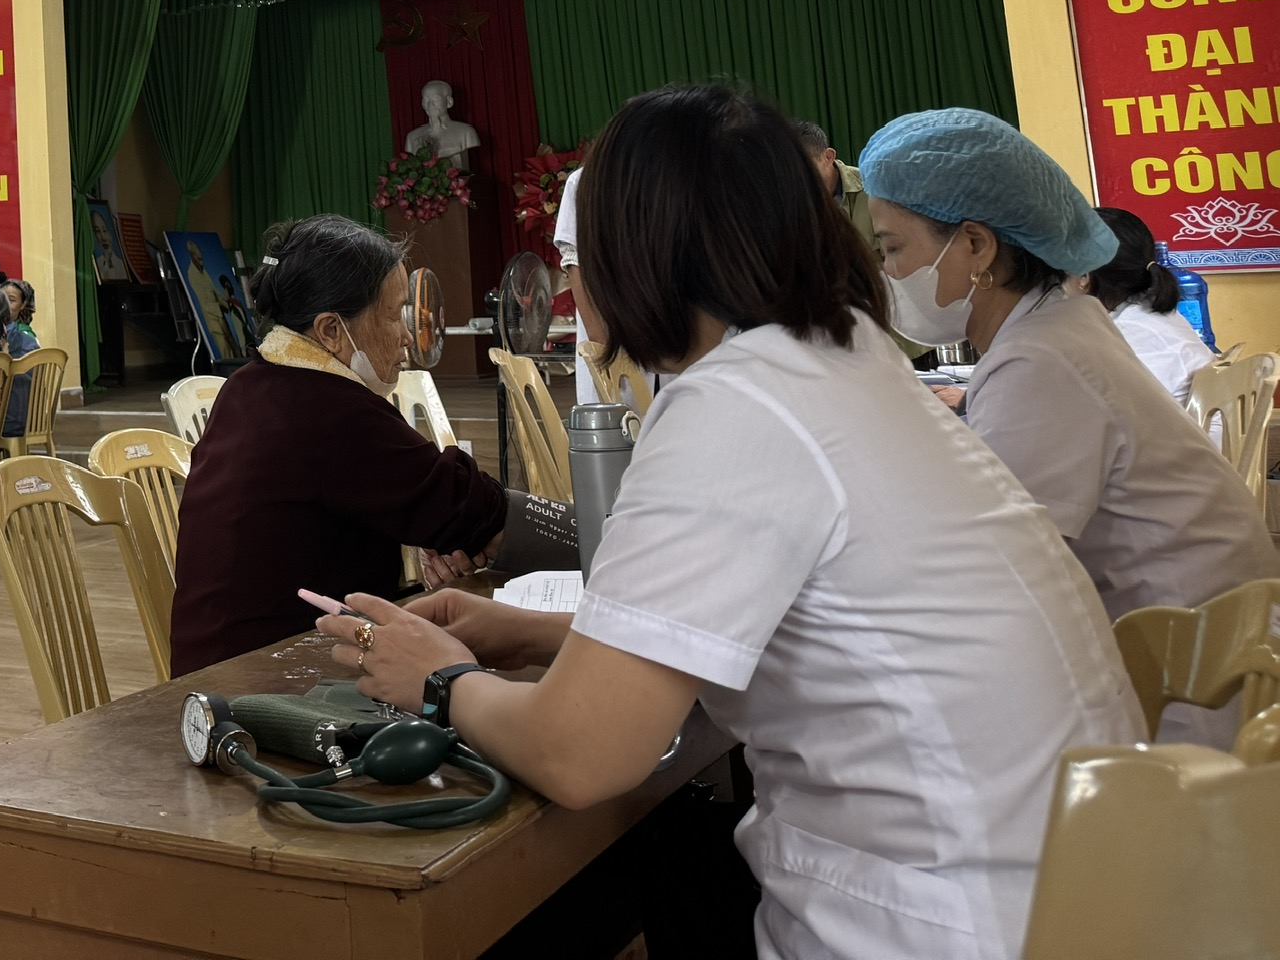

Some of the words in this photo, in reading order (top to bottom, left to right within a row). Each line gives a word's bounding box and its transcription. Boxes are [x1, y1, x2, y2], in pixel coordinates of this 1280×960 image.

[1145, 26, 1254, 76] ĐẠI
[1102, 84, 1280, 135] THÀN
[526, 502, 562, 520] ADULT
